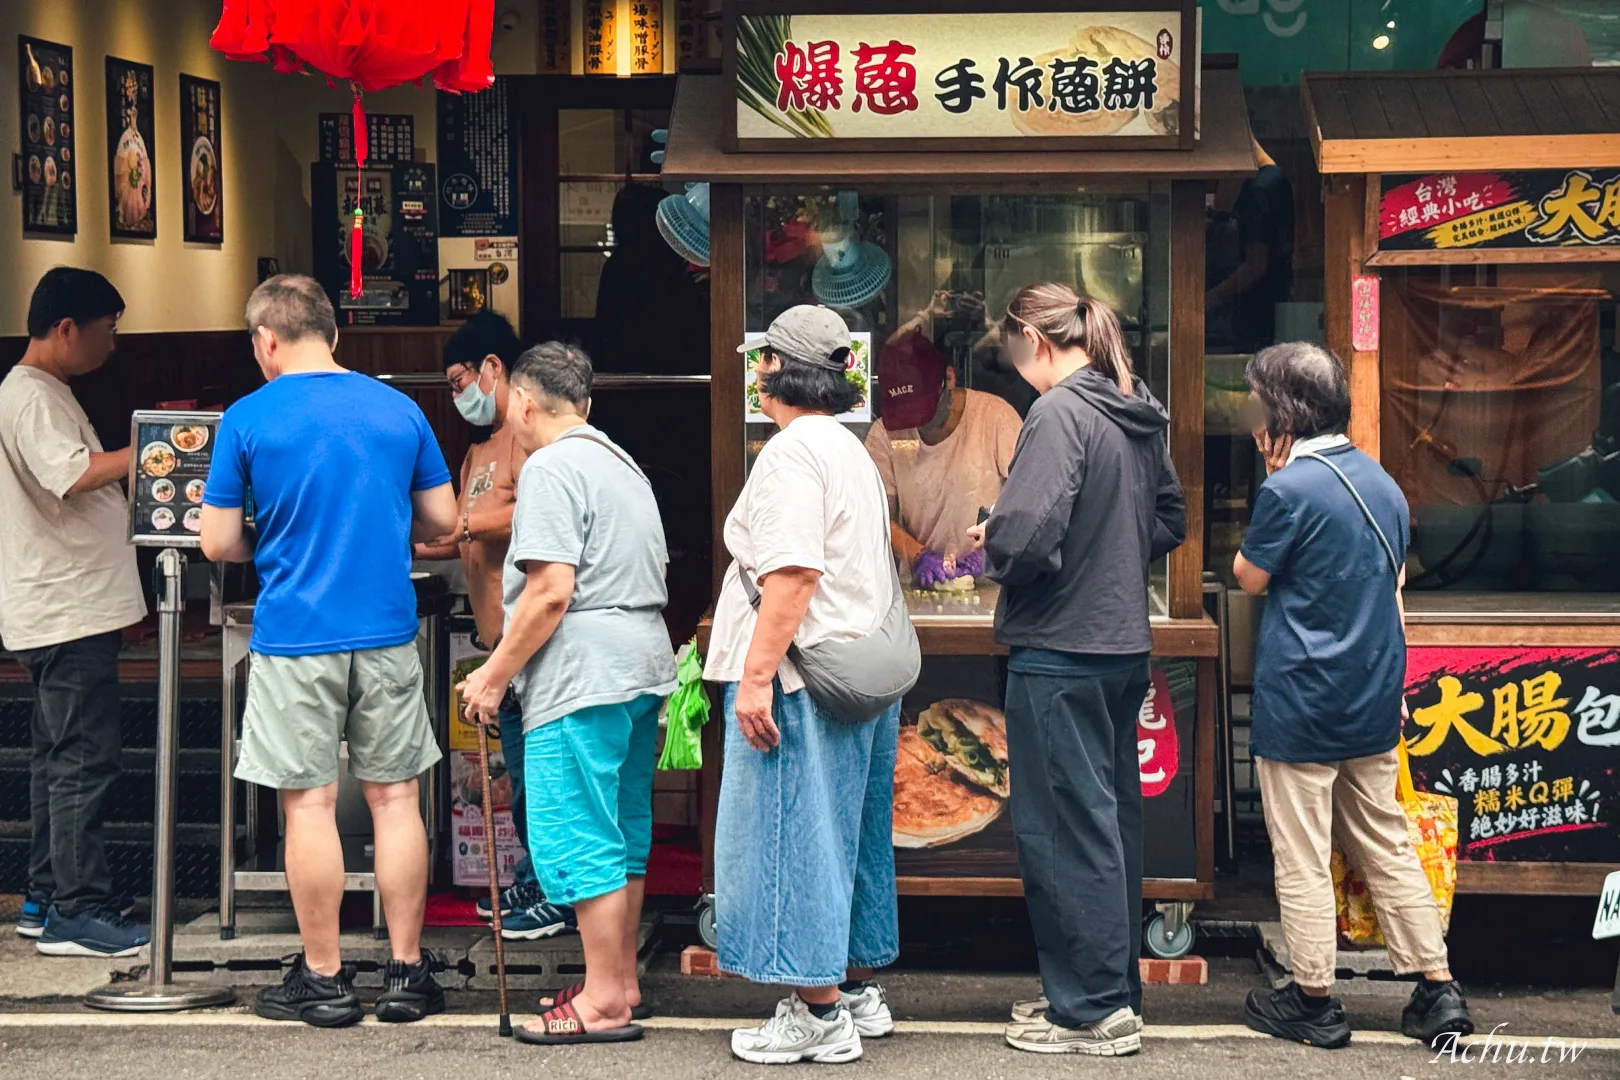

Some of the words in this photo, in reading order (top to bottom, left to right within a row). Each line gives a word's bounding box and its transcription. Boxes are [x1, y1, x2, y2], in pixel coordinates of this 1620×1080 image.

[605, 10, 615, 60] ラーメン
[651, 20, 661, 60] ラーメン
[775, 39, 919, 115] 爆蔥
[934, 56, 1158, 115] 手作蔥餅
[1415, 176, 1457, 203] 台灣
[1398, 192, 1484, 227] 經典小吃
[1458, 760, 1543, 793] 香腸多汁
[1473, 776, 1575, 816] 糯米Q彈
[550, 1019, 578, 1033] Rich
